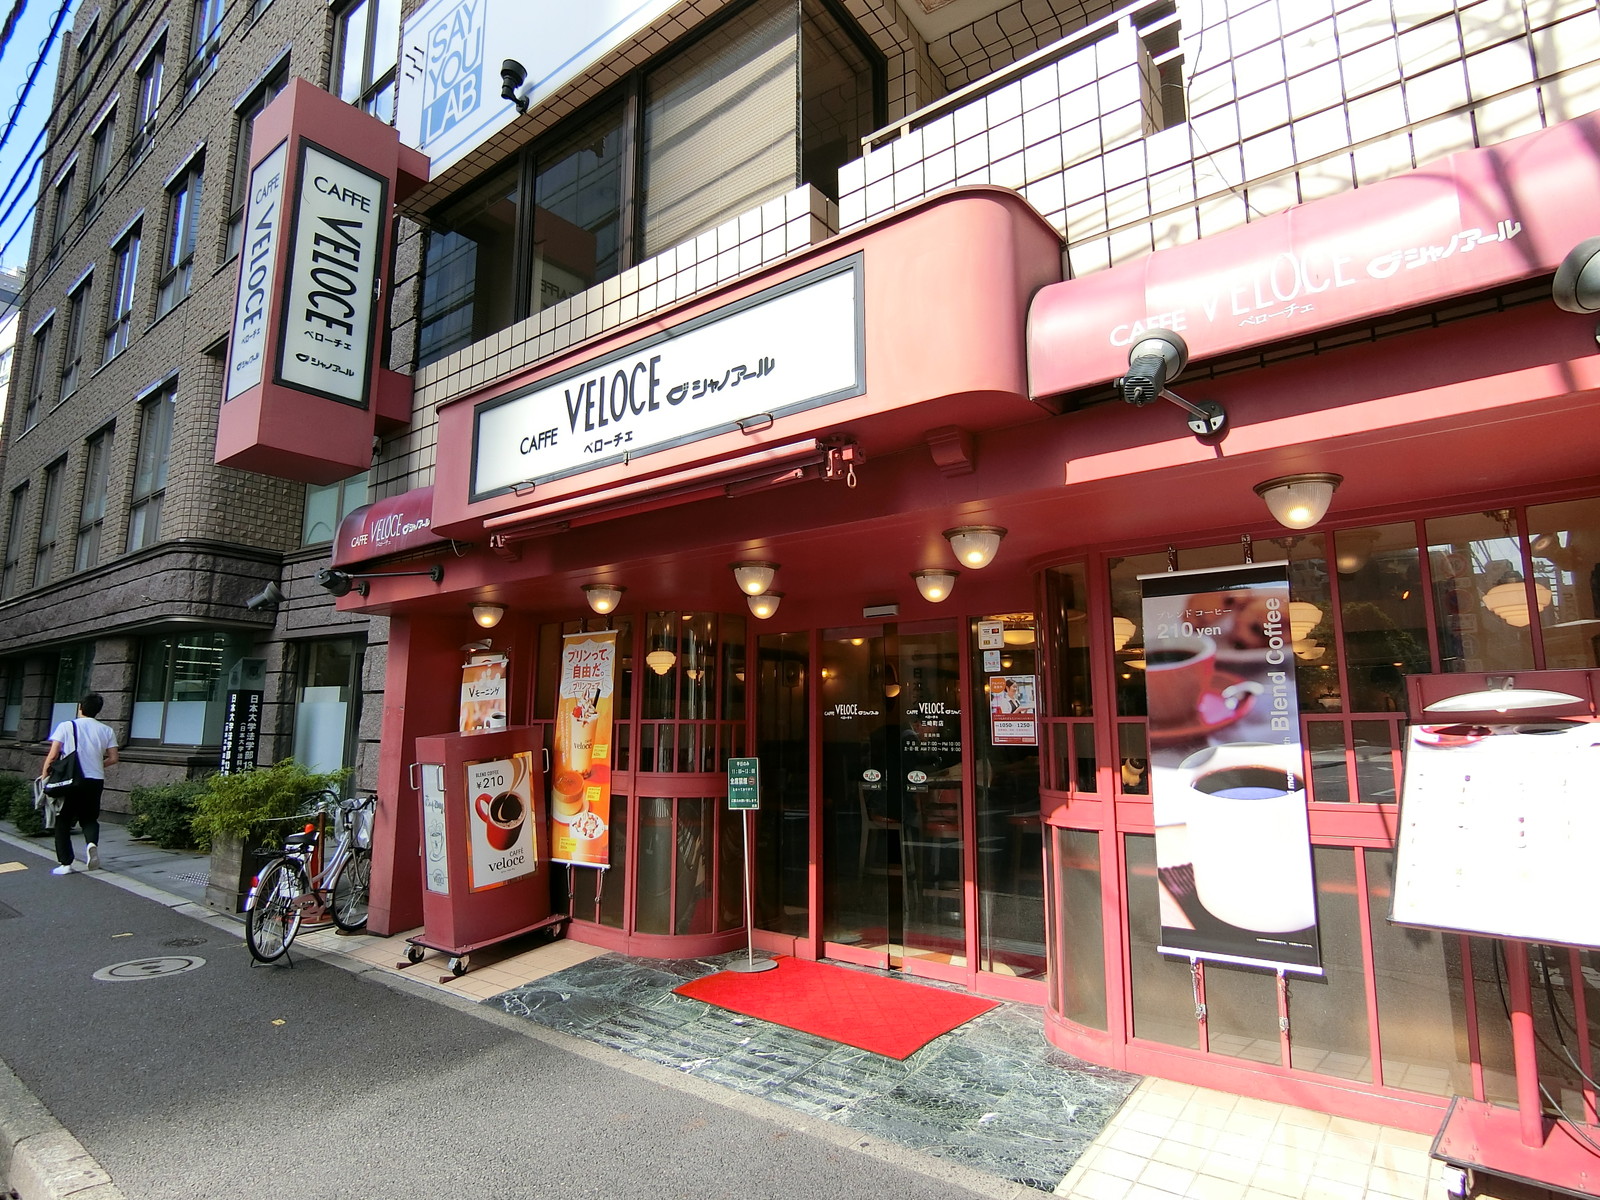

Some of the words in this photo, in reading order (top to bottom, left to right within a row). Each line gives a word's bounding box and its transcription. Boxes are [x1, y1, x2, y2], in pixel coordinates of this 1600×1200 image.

[432, 0, 478, 63] SAY
[429, 26, 481, 100] YOU
[425, 73, 477, 147] LAB
[256, 172, 280, 204] CAFFE
[313, 176, 371, 213] CAFFE
[243, 201, 275, 331] VELOCE
[305, 216, 363, 337] VELOCE
[1109, 309, 1187, 347] CAFFE
[1201, 252, 1356, 322] VELOCE
[1404, 219, 1522, 269] シャノアール
[1239, 302, 1315, 327] ベローチェ
[241, 327, 261, 344] ベローチェ
[304, 330, 352, 350] ベローチェ
[311, 357, 355, 377] シャノアール
[520, 427, 558, 455] CAFFE
[564, 355, 661, 434] VELOCE
[692, 356, 775, 399] シャノアール
[583, 430, 633, 453] ベローチェ
[351, 534, 369, 548] CAFFE
[371, 513, 404, 542] VELOCE
[1195, 608, 1232, 617] コーヒー
[1157, 621, 1194, 639] 210
[1196, 626, 1222, 638] yen
[1263, 597, 1285, 665] Coffee
[568, 648, 609, 663] プリンって、
[573, 662, 604, 679] 自由だ。
[835, 704, 858, 715] VELOCE
[918, 702, 945, 714] VELOCE
[1267, 671, 1290, 731] Blend
[477, 775, 504, 789] ¥210
[488, 855, 525, 872] veloce
